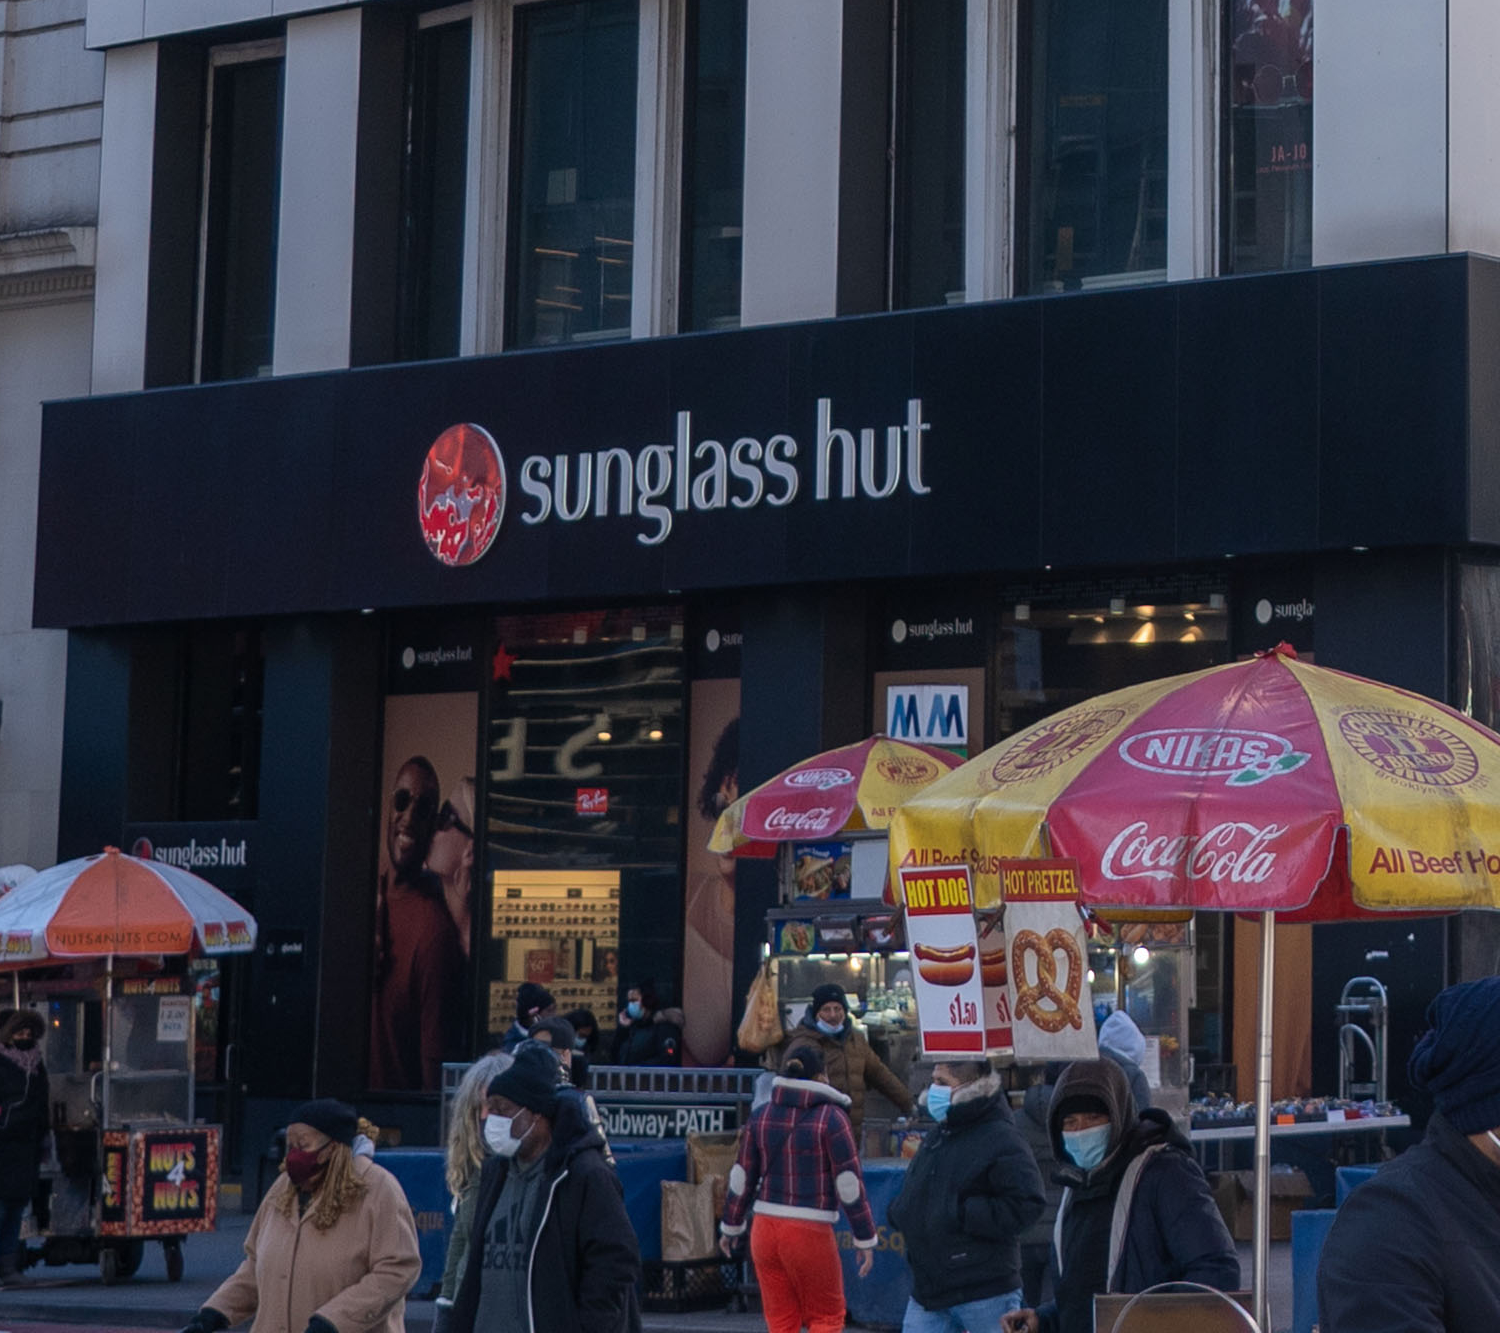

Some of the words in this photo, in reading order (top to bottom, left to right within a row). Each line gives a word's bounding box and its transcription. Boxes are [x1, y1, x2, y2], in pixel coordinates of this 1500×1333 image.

[520, 403, 799, 547] sunglass
[815, 397, 933, 503] hut
[1275, 598, 1313, 621] sungla
[908, 619, 951, 639] sunglass
[954, 616, 973, 633] hut
[1145, 735, 1269, 767] NIKAS
[155, 841, 219, 870] sunglass
[221, 839, 247, 866] hut
[1101, 821, 1289, 884] Coca-Cola
[1369, 847, 1405, 874] All
[1407, 848, 1464, 874] Beef
[905, 880, 936, 909] HOT
[938, 877, 969, 907] DOG
[1002, 870, 1026, 895] HOT
[1027, 869, 1079, 895] PRETZEL
[54, 931, 183, 948] NUTS4NUTS.COM
[949, 992, 978, 1026] $1.50
[600, 1107, 725, 1139] Subway-PATH
[150, 1141, 196, 1173] NUTS
[166, 1160, 186, 1187] 4
[153, 1180, 200, 1211] NUTS
